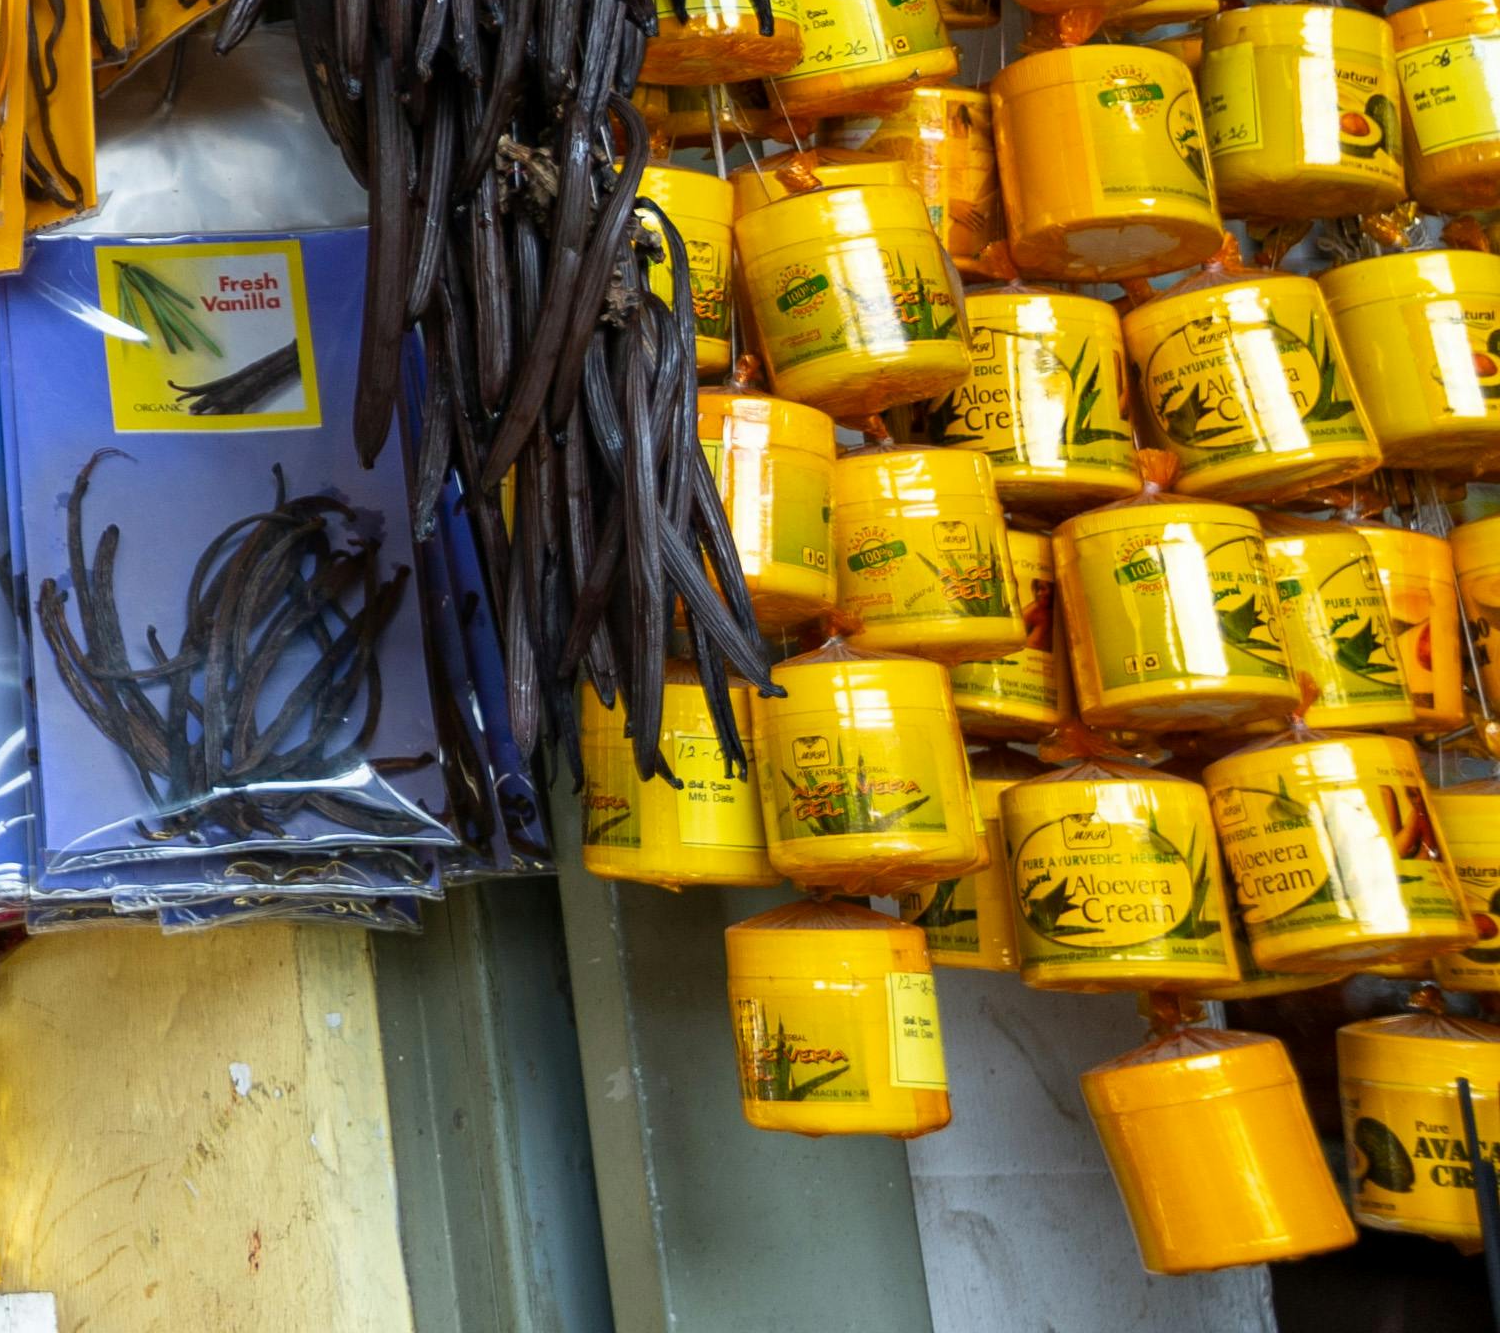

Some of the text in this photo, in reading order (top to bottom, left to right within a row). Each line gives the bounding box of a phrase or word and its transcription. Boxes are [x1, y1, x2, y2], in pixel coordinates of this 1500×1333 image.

[218, 275, 279, 293] Fresh
[787, 282, 817, 305] 100%
[202, 292, 283, 313] Vanilla
[133, 403, 186, 415] ORGANIC
[859, 547, 894, 563] 100%
[941, 580, 991, 601] GEL
[1324, 598, 1351, 609] PURE
[688, 792, 735, 804] Mfd. Date
[792, 778, 921, 800] ALOE VERA
[794, 799, 843, 821] GEL
[1023, 856, 1044, 870] PURE
[1048, 853, 1122, 866] AYURVEDIC
[1233, 843, 1308, 872] Aloevera
[1072, 875, 1173, 897] Aloevera
[1240, 865, 1315, 900] Cream
[1081, 897, 1176, 924] Cream
[811, 1089, 837, 1099] MADE
[1416, 1121, 1449, 1134] Pure
